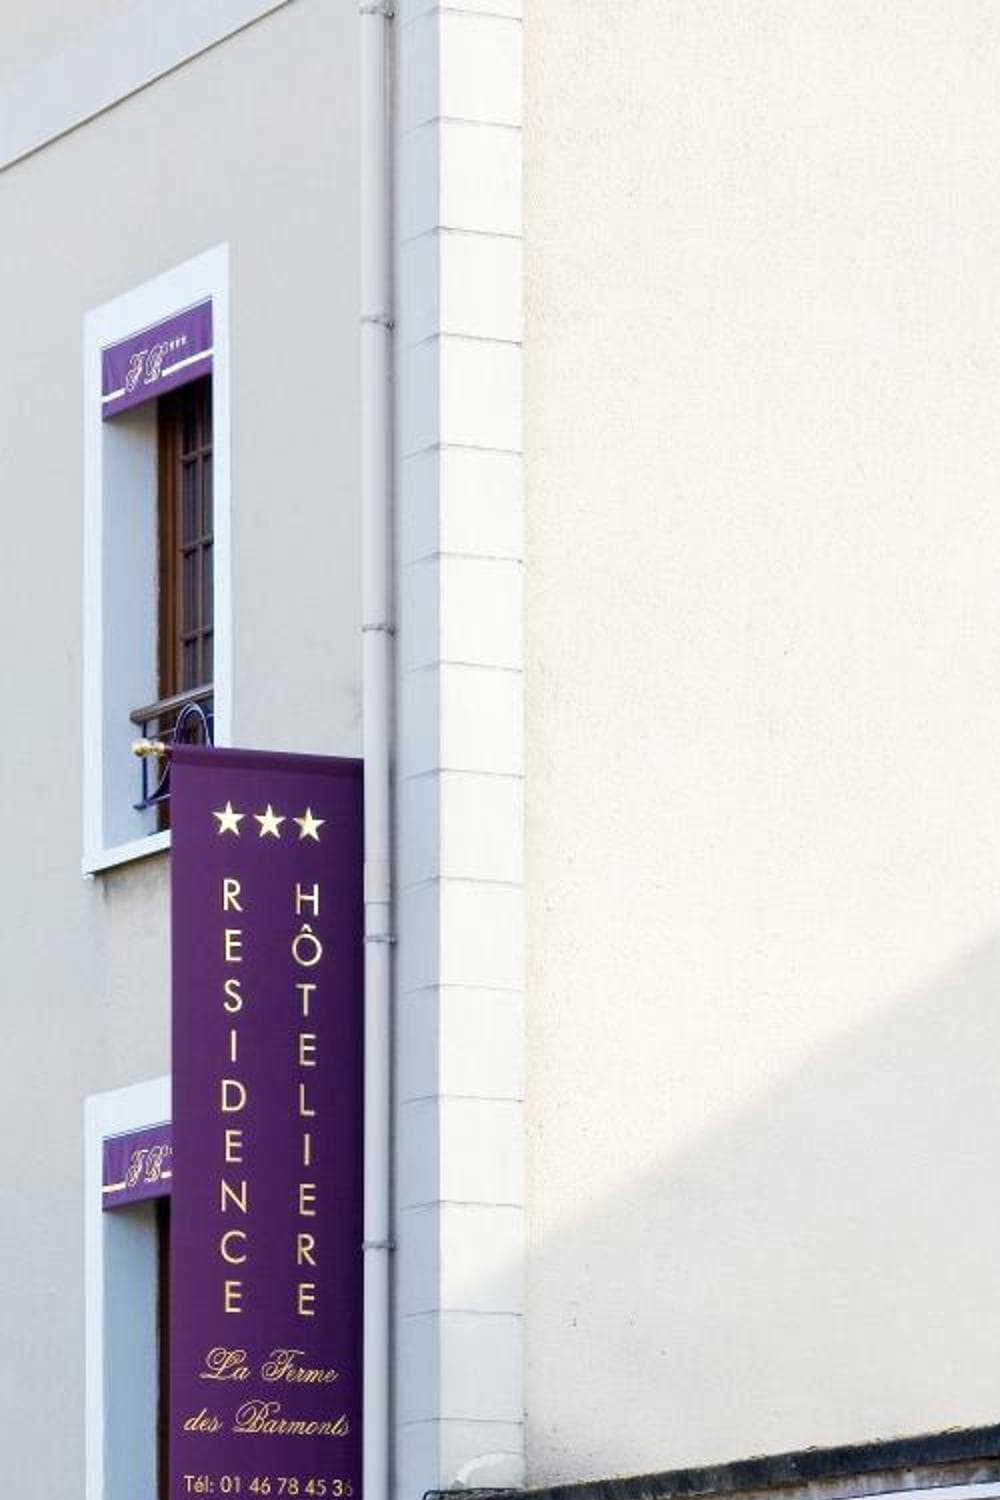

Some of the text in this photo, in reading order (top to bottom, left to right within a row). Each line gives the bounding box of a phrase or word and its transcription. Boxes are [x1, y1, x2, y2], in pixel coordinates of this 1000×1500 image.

[220, 878, 247, 1312] RESIDENCE
[292, 883, 322, 1315] HÔTELIERE
[200, 1347, 339, 1383] La Ferme
[184, 1400, 349, 1436] des Barmonts
[184, 1475, 353, 1496] Tél: 01 46 78 45 36
